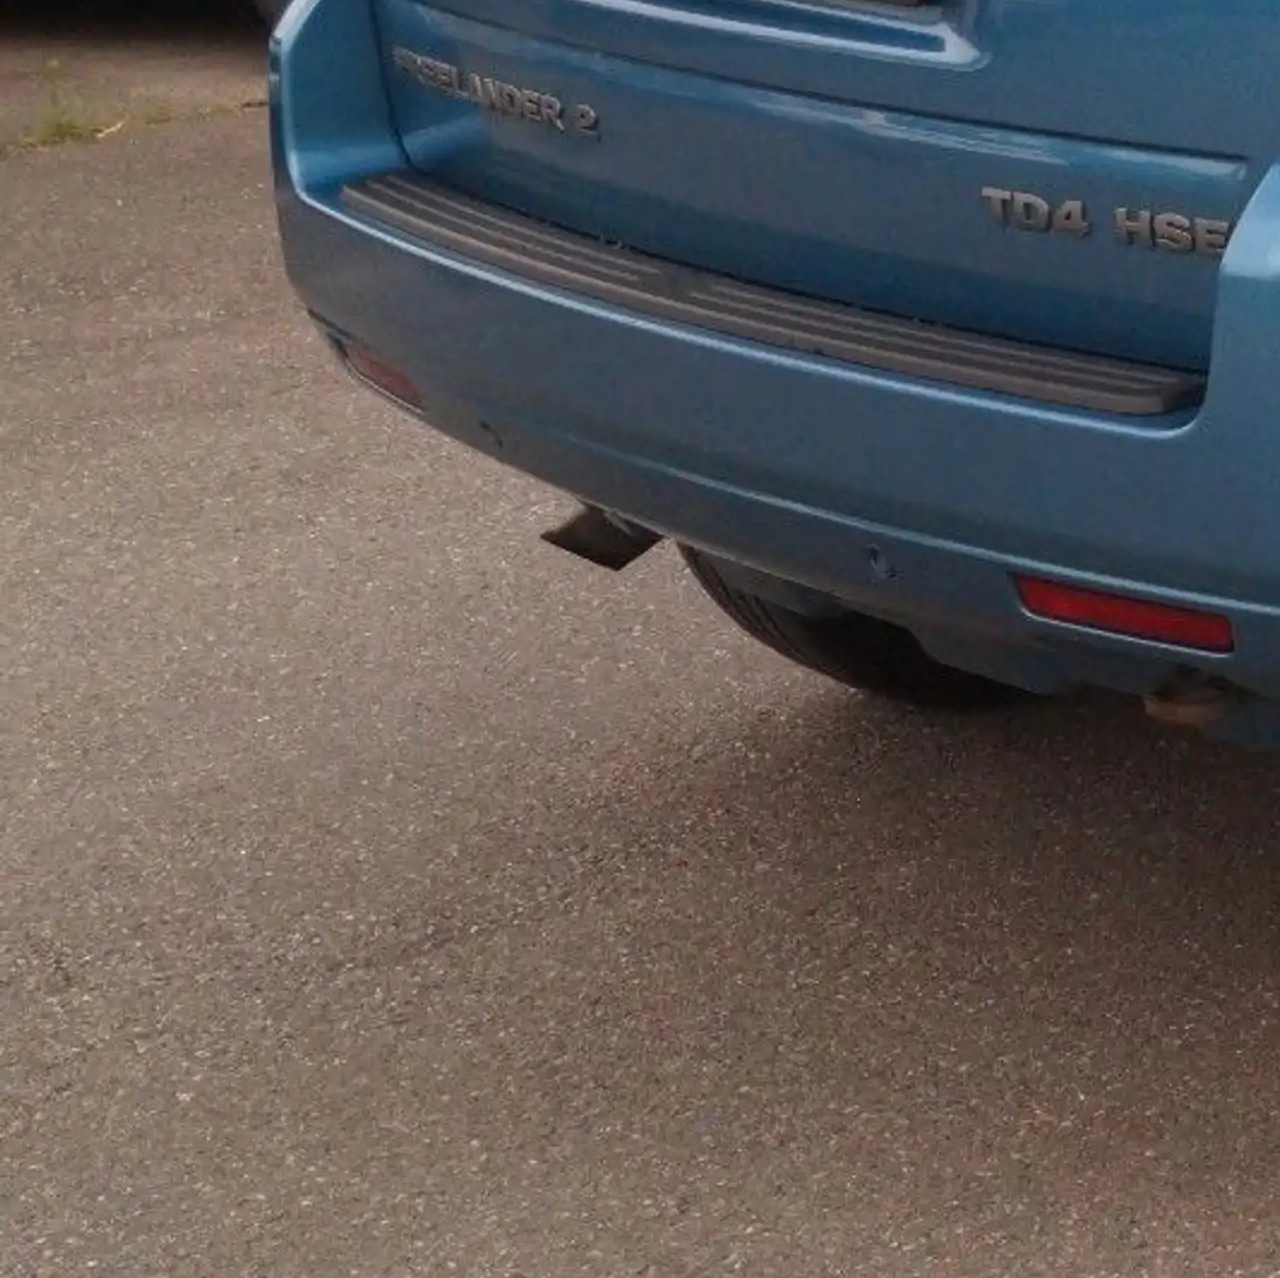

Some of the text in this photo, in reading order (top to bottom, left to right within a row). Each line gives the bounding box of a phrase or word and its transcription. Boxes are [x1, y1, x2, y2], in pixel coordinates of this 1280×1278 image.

[573, 103, 603, 135] 2
[981, 186, 1230, 256] TD4 HSE
